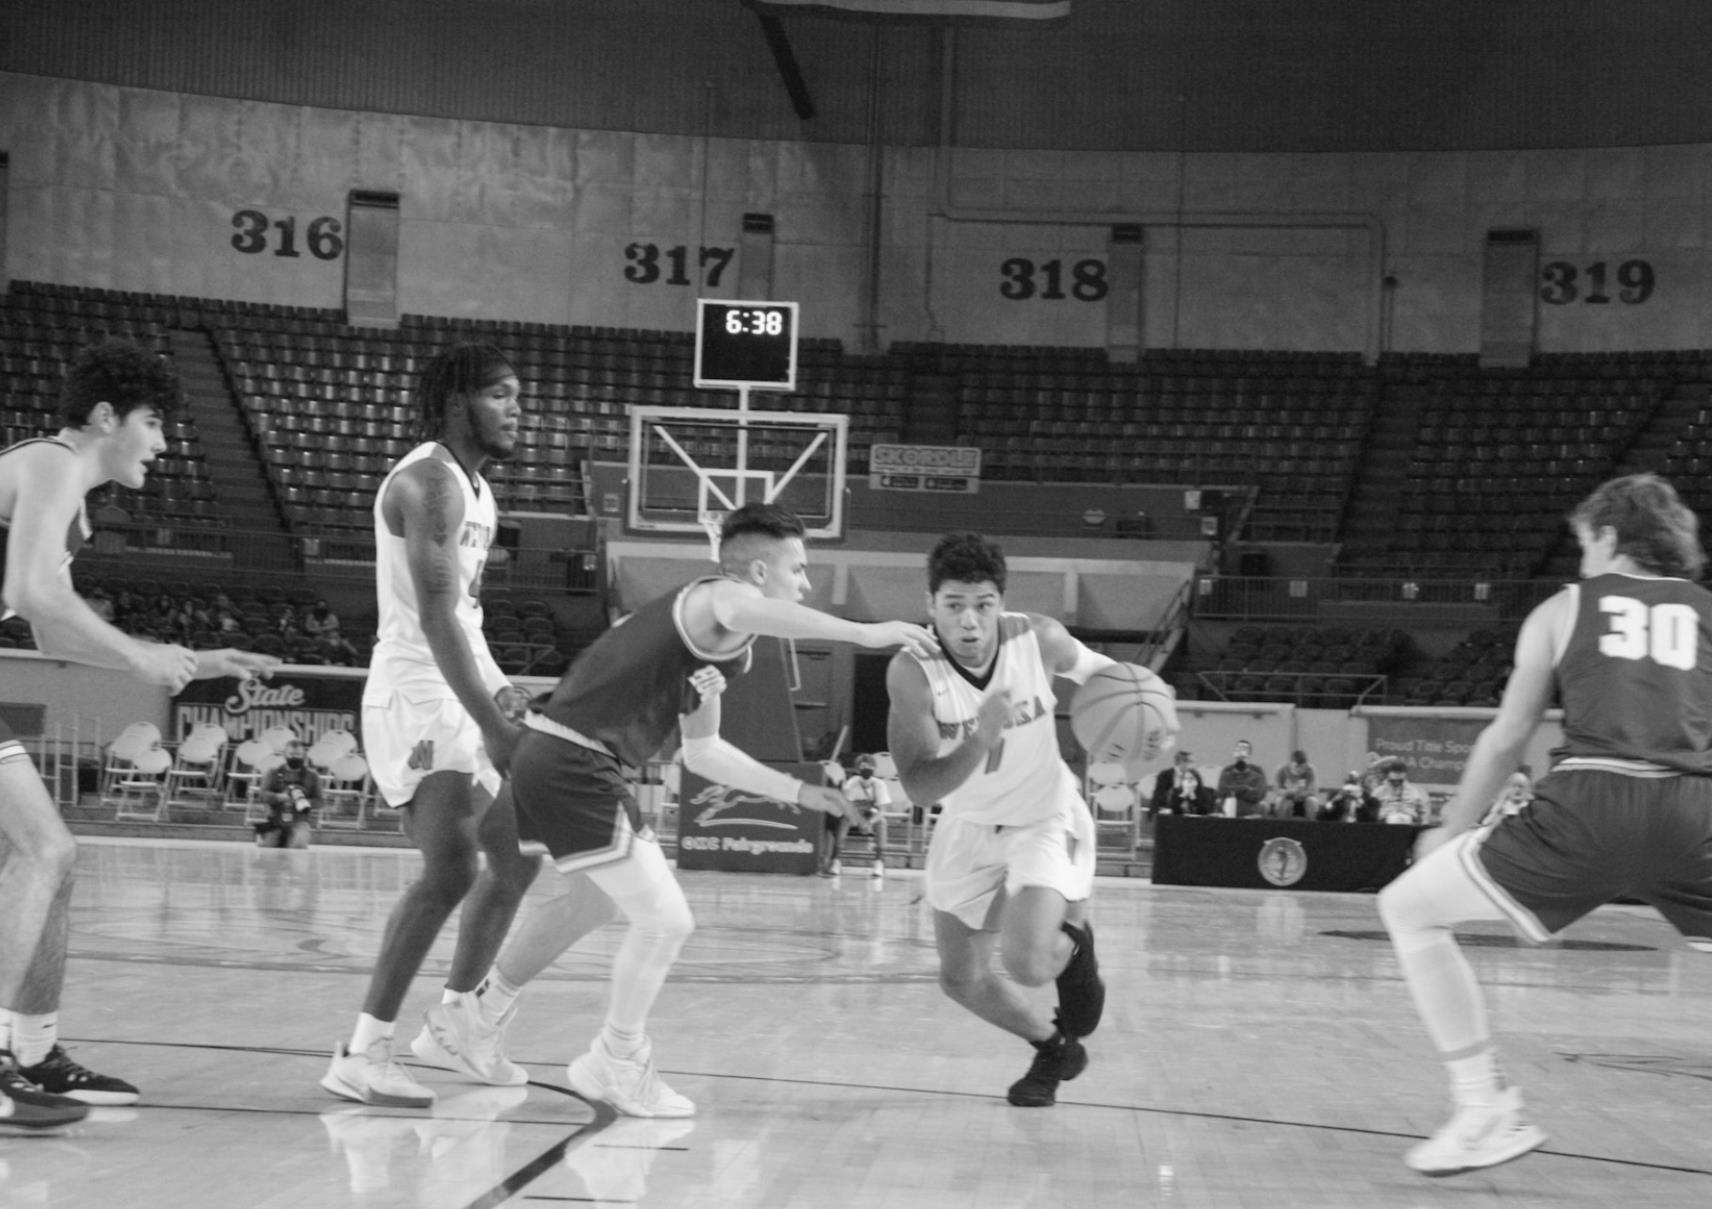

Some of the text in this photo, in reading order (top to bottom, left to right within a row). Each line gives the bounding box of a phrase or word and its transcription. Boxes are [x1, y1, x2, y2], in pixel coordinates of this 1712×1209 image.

[231, 210, 344, 260] 316
[624, 242, 735, 287] 317
[1000, 258, 1108, 302] 318
[1541, 260, 1656, 305] 319
[725, 309, 783, 336] 6:38
[1598, 594, 1699, 671] 30
[225, 677, 305, 714] State
